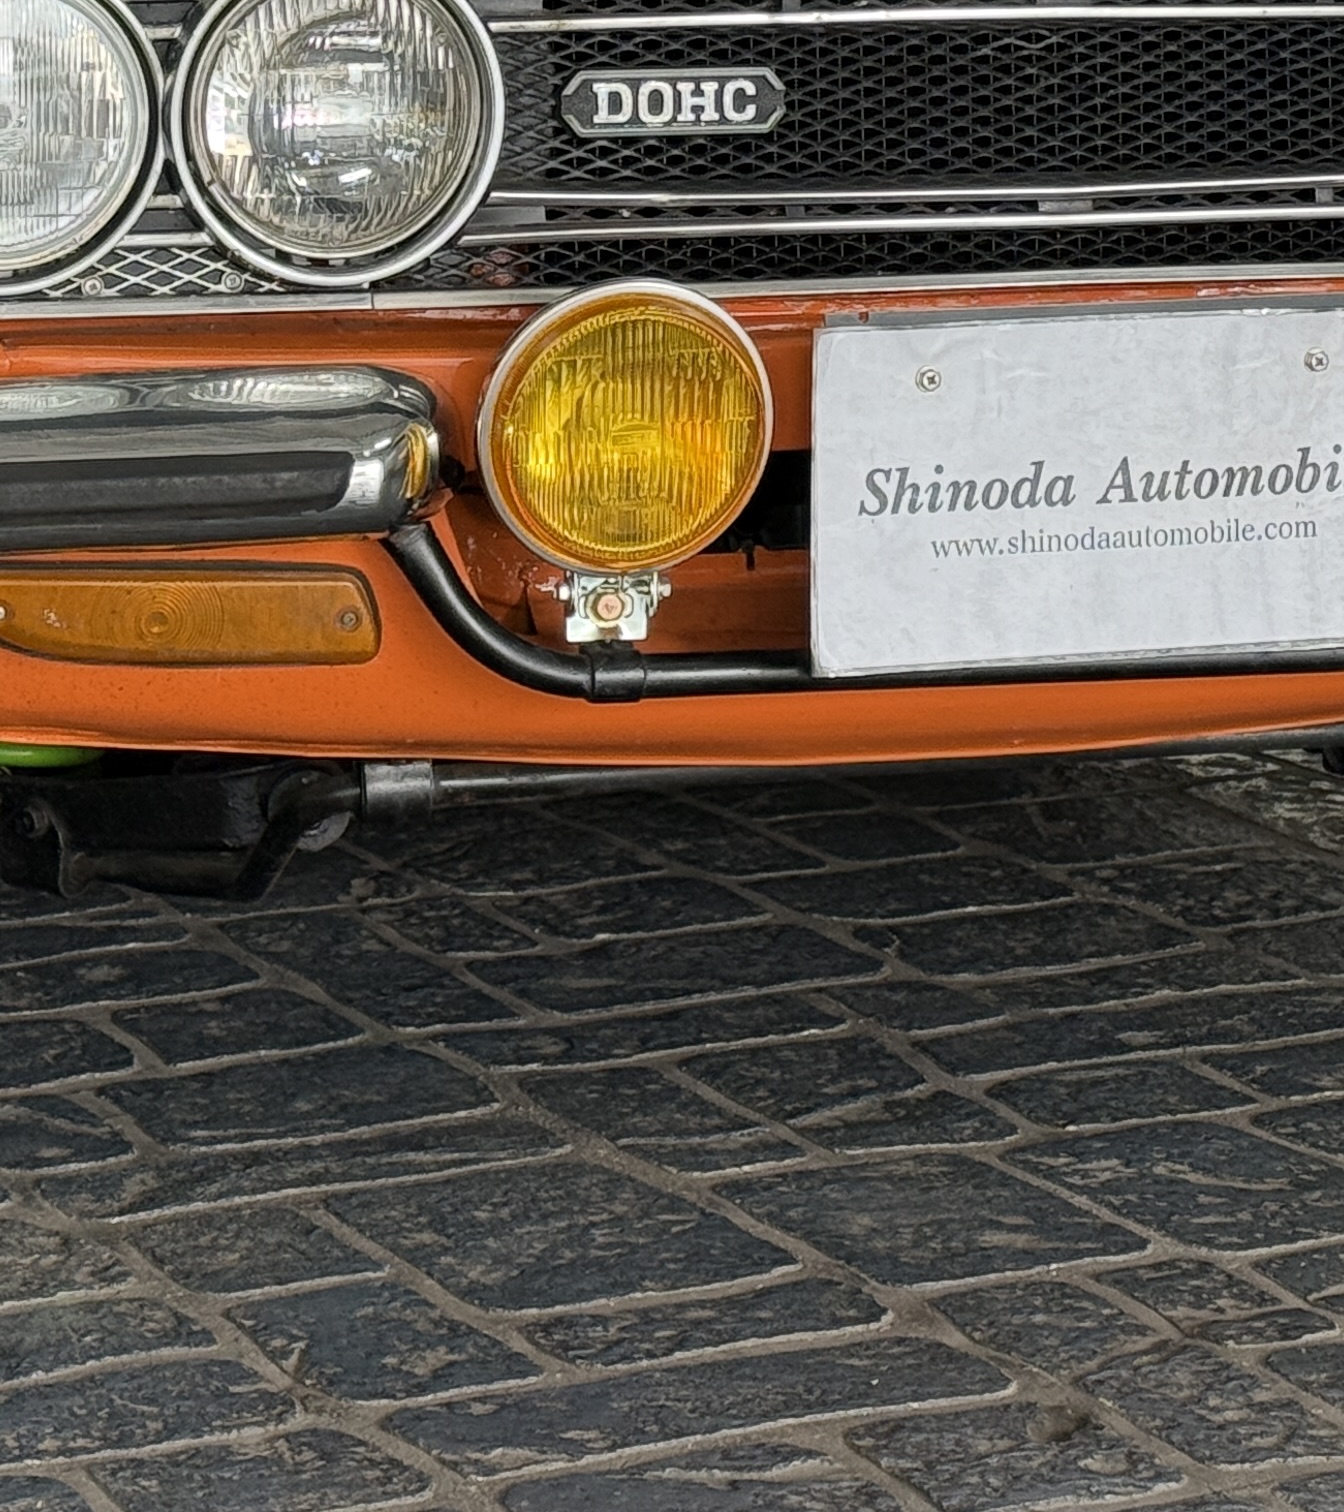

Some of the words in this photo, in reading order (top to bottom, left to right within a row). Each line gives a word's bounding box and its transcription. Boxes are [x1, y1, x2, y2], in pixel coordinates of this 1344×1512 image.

[592, 78, 756, 124] DOHC
[858, 460, 1076, 516] Shinoda
[931, 519, 1317, 558] www.shinodaautomobile.com
